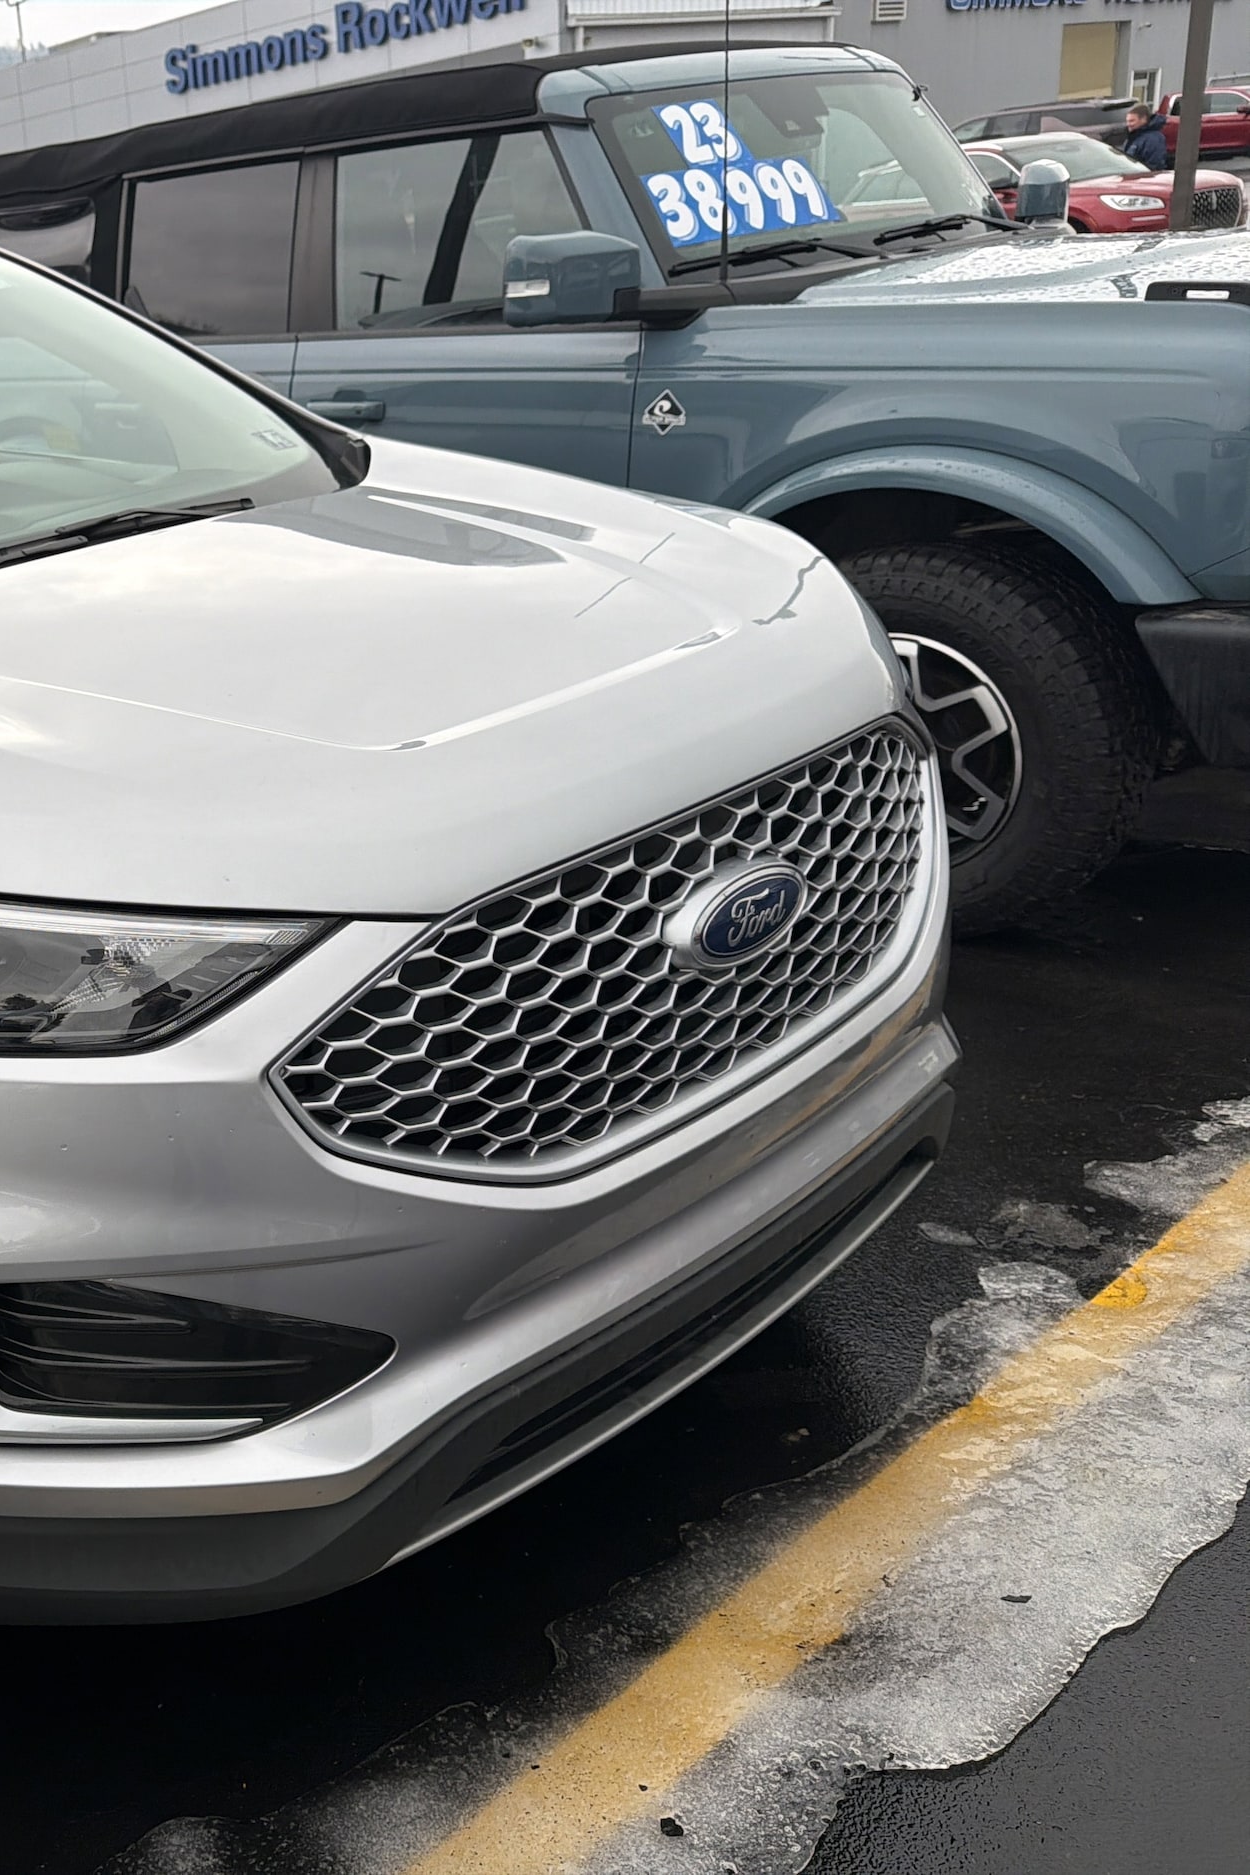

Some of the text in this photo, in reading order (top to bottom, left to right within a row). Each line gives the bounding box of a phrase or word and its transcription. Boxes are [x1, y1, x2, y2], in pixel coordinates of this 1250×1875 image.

[165, 23, 328, 94] Simmons
[660, 102, 742, 164] 23
[647, 159, 829, 240] 38999
[727, 888, 786, 947] Ford
